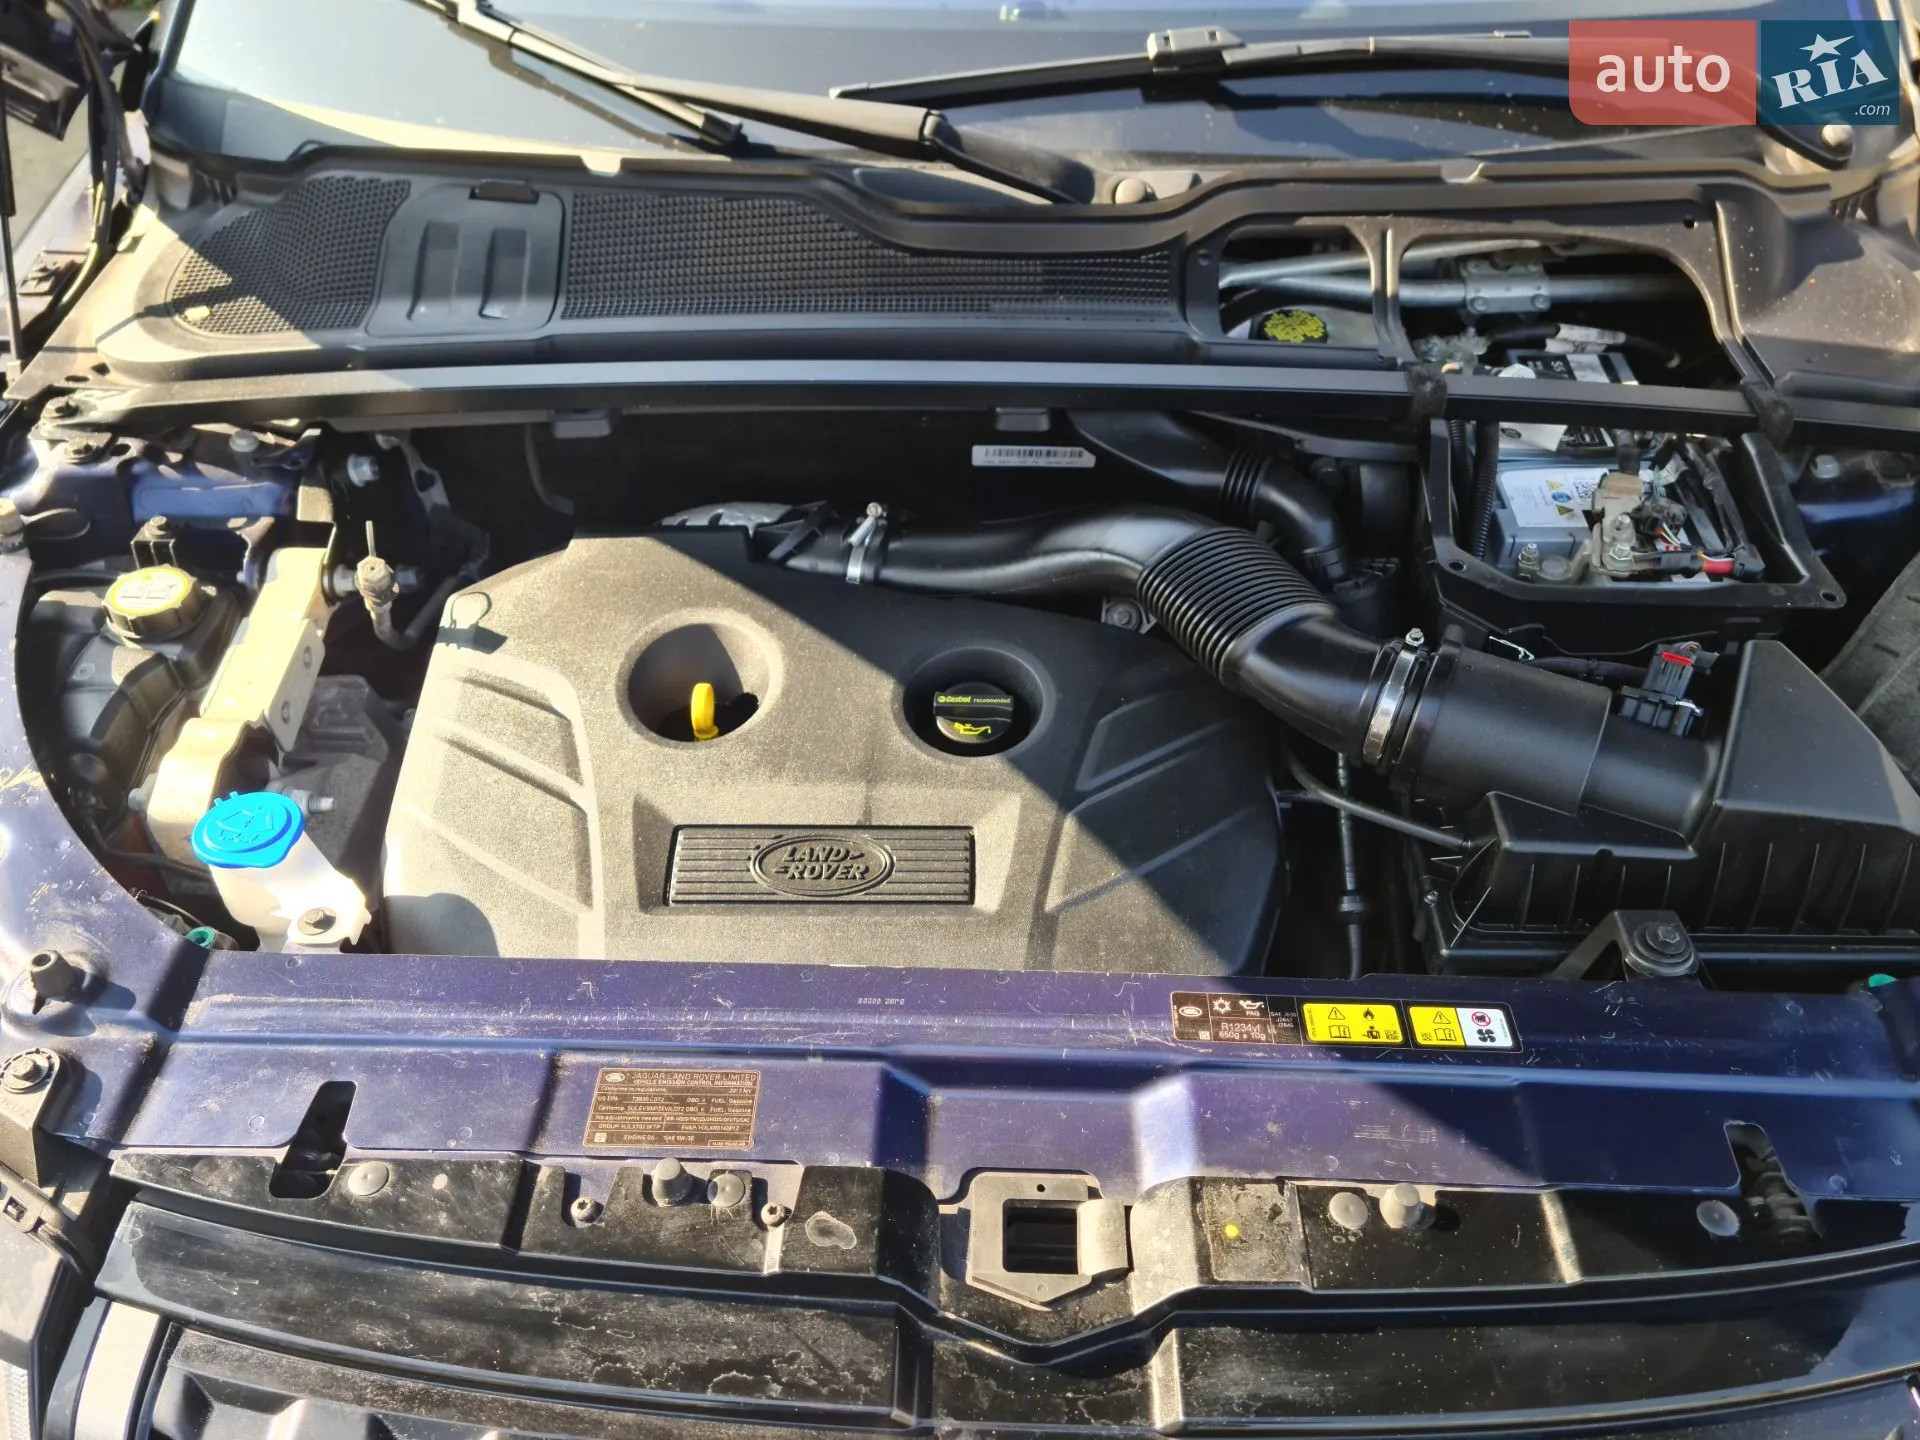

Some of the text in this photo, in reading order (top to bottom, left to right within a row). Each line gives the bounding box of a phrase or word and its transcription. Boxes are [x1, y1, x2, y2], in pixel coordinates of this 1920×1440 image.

[782, 846, 850, 863] LAND
[786, 863, 869, 880] ROVER
[1221, 1022, 1261, 1033] R1234yf
[1250, 1032, 1266, 1041] 10g
[693, 1073, 721, 1081] ROVER
